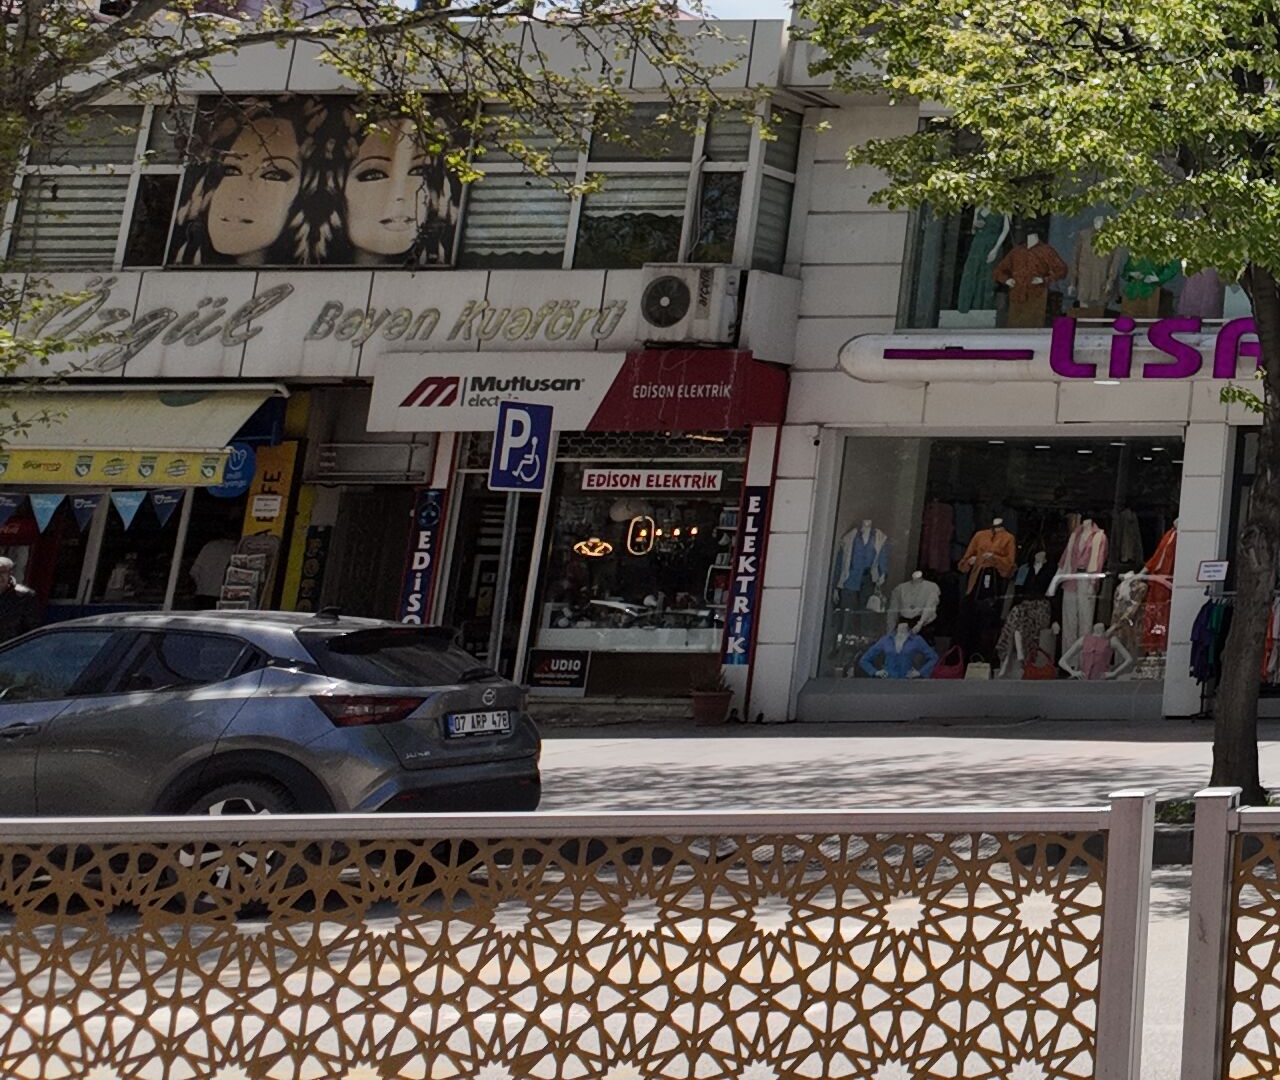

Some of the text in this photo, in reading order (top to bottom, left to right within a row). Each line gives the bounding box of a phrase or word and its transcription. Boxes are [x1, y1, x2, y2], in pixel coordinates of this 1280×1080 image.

[305, 299, 628, 348] Bayan Kuaförü
[470, 376, 581, 392] Mutlusan
[633, 383, 732, 399] EDİSON ELEKTRİK
[500, 408, 531, 471] P
[586, 472, 718, 489] EDİSON ELEKTRİK
[727, 496, 761, 654] ELEKTRİK
[454, 712, 508, 731] 07 ARP 478
